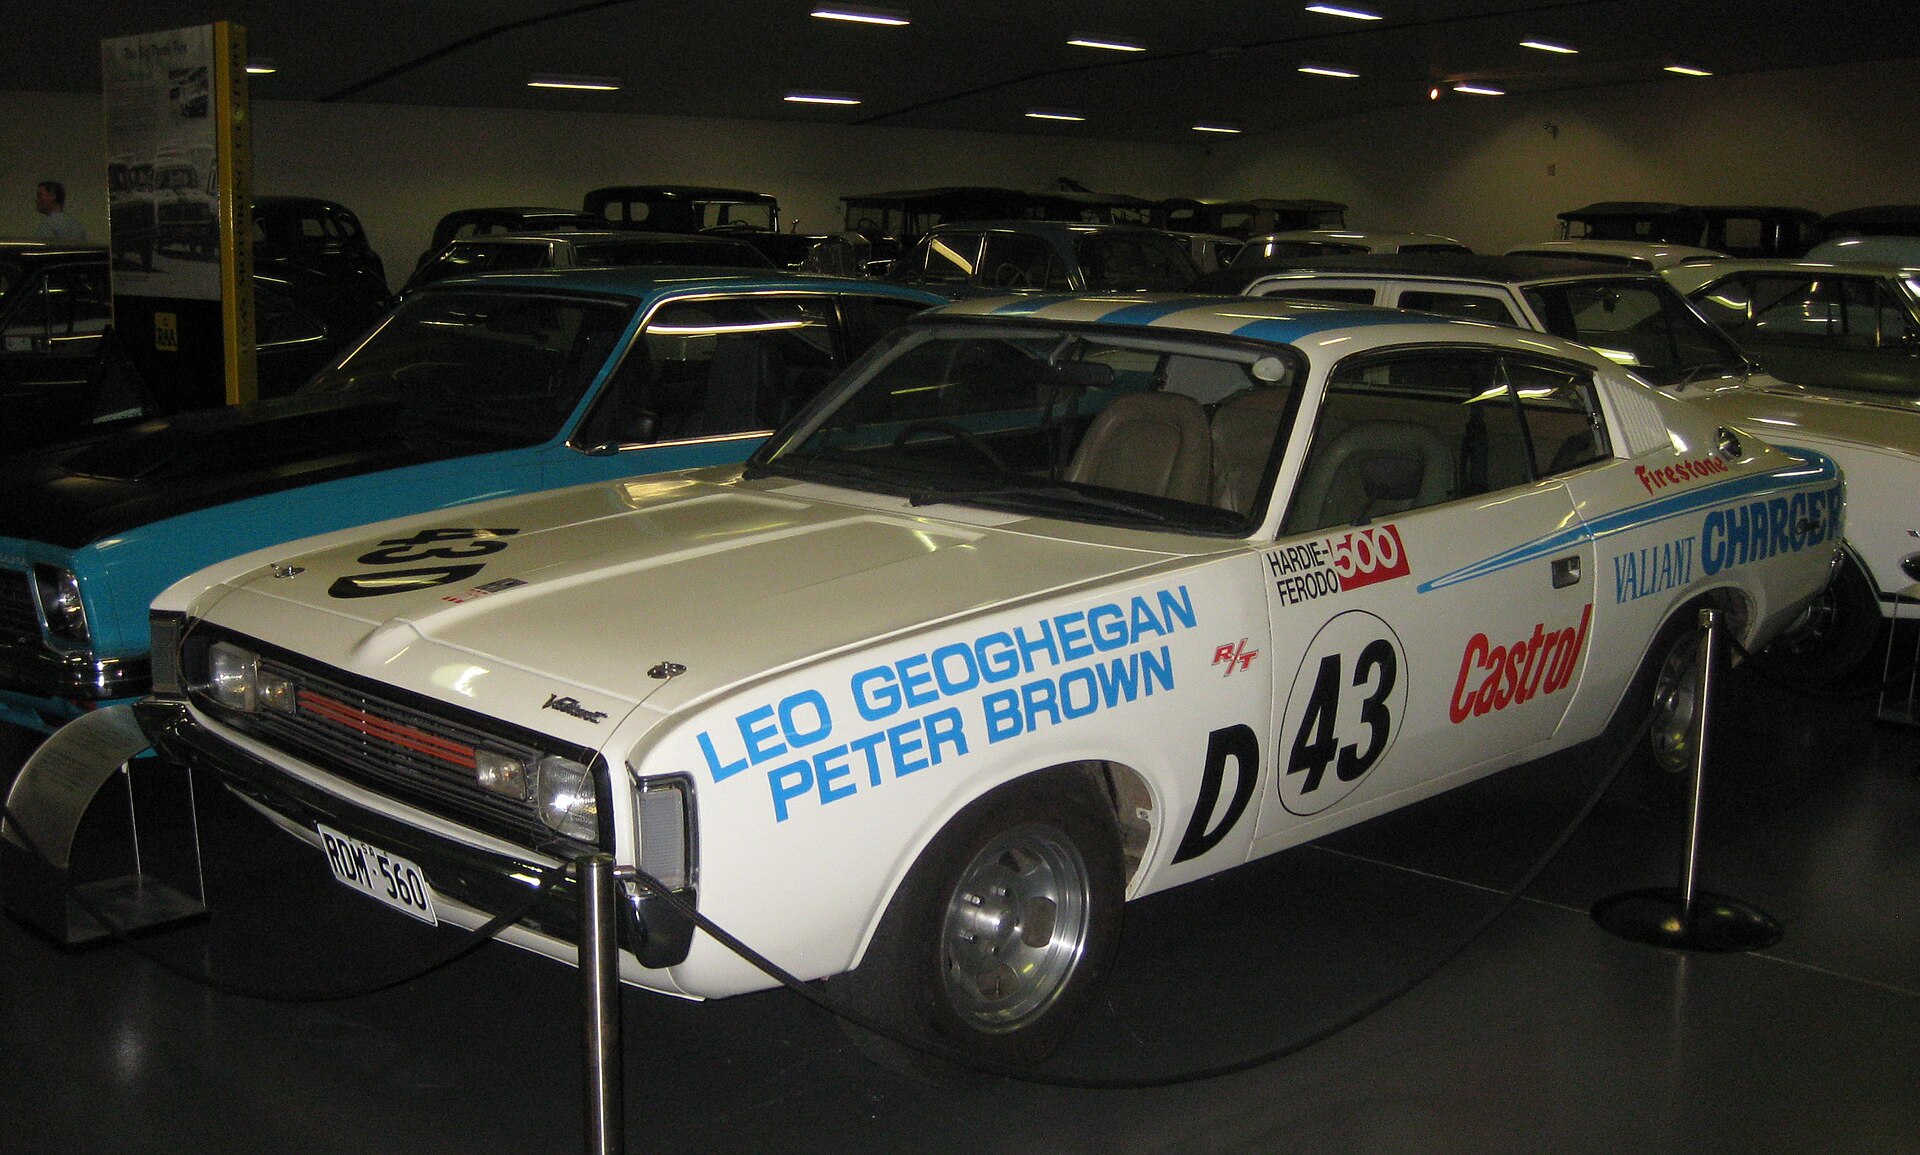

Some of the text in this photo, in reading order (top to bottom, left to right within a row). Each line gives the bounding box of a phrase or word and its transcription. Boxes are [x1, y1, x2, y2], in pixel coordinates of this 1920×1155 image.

[1634, 456, 1728, 496] Firestone
[1277, 567, 1339, 607] FERODO
[1332, 525, 1399, 579] 500
[1613, 484, 1845, 604] VALIANT CHARGER
[696, 585, 1197, 783] LEO GEOGHEGAN
[1211, 637, 1260, 678] R/T
[1287, 639, 1397, 795] 43
[1449, 603, 1592, 725] Castrol
[767, 645, 1175, 823] PETER BROWN
[1171, 723, 1260, 867] D
